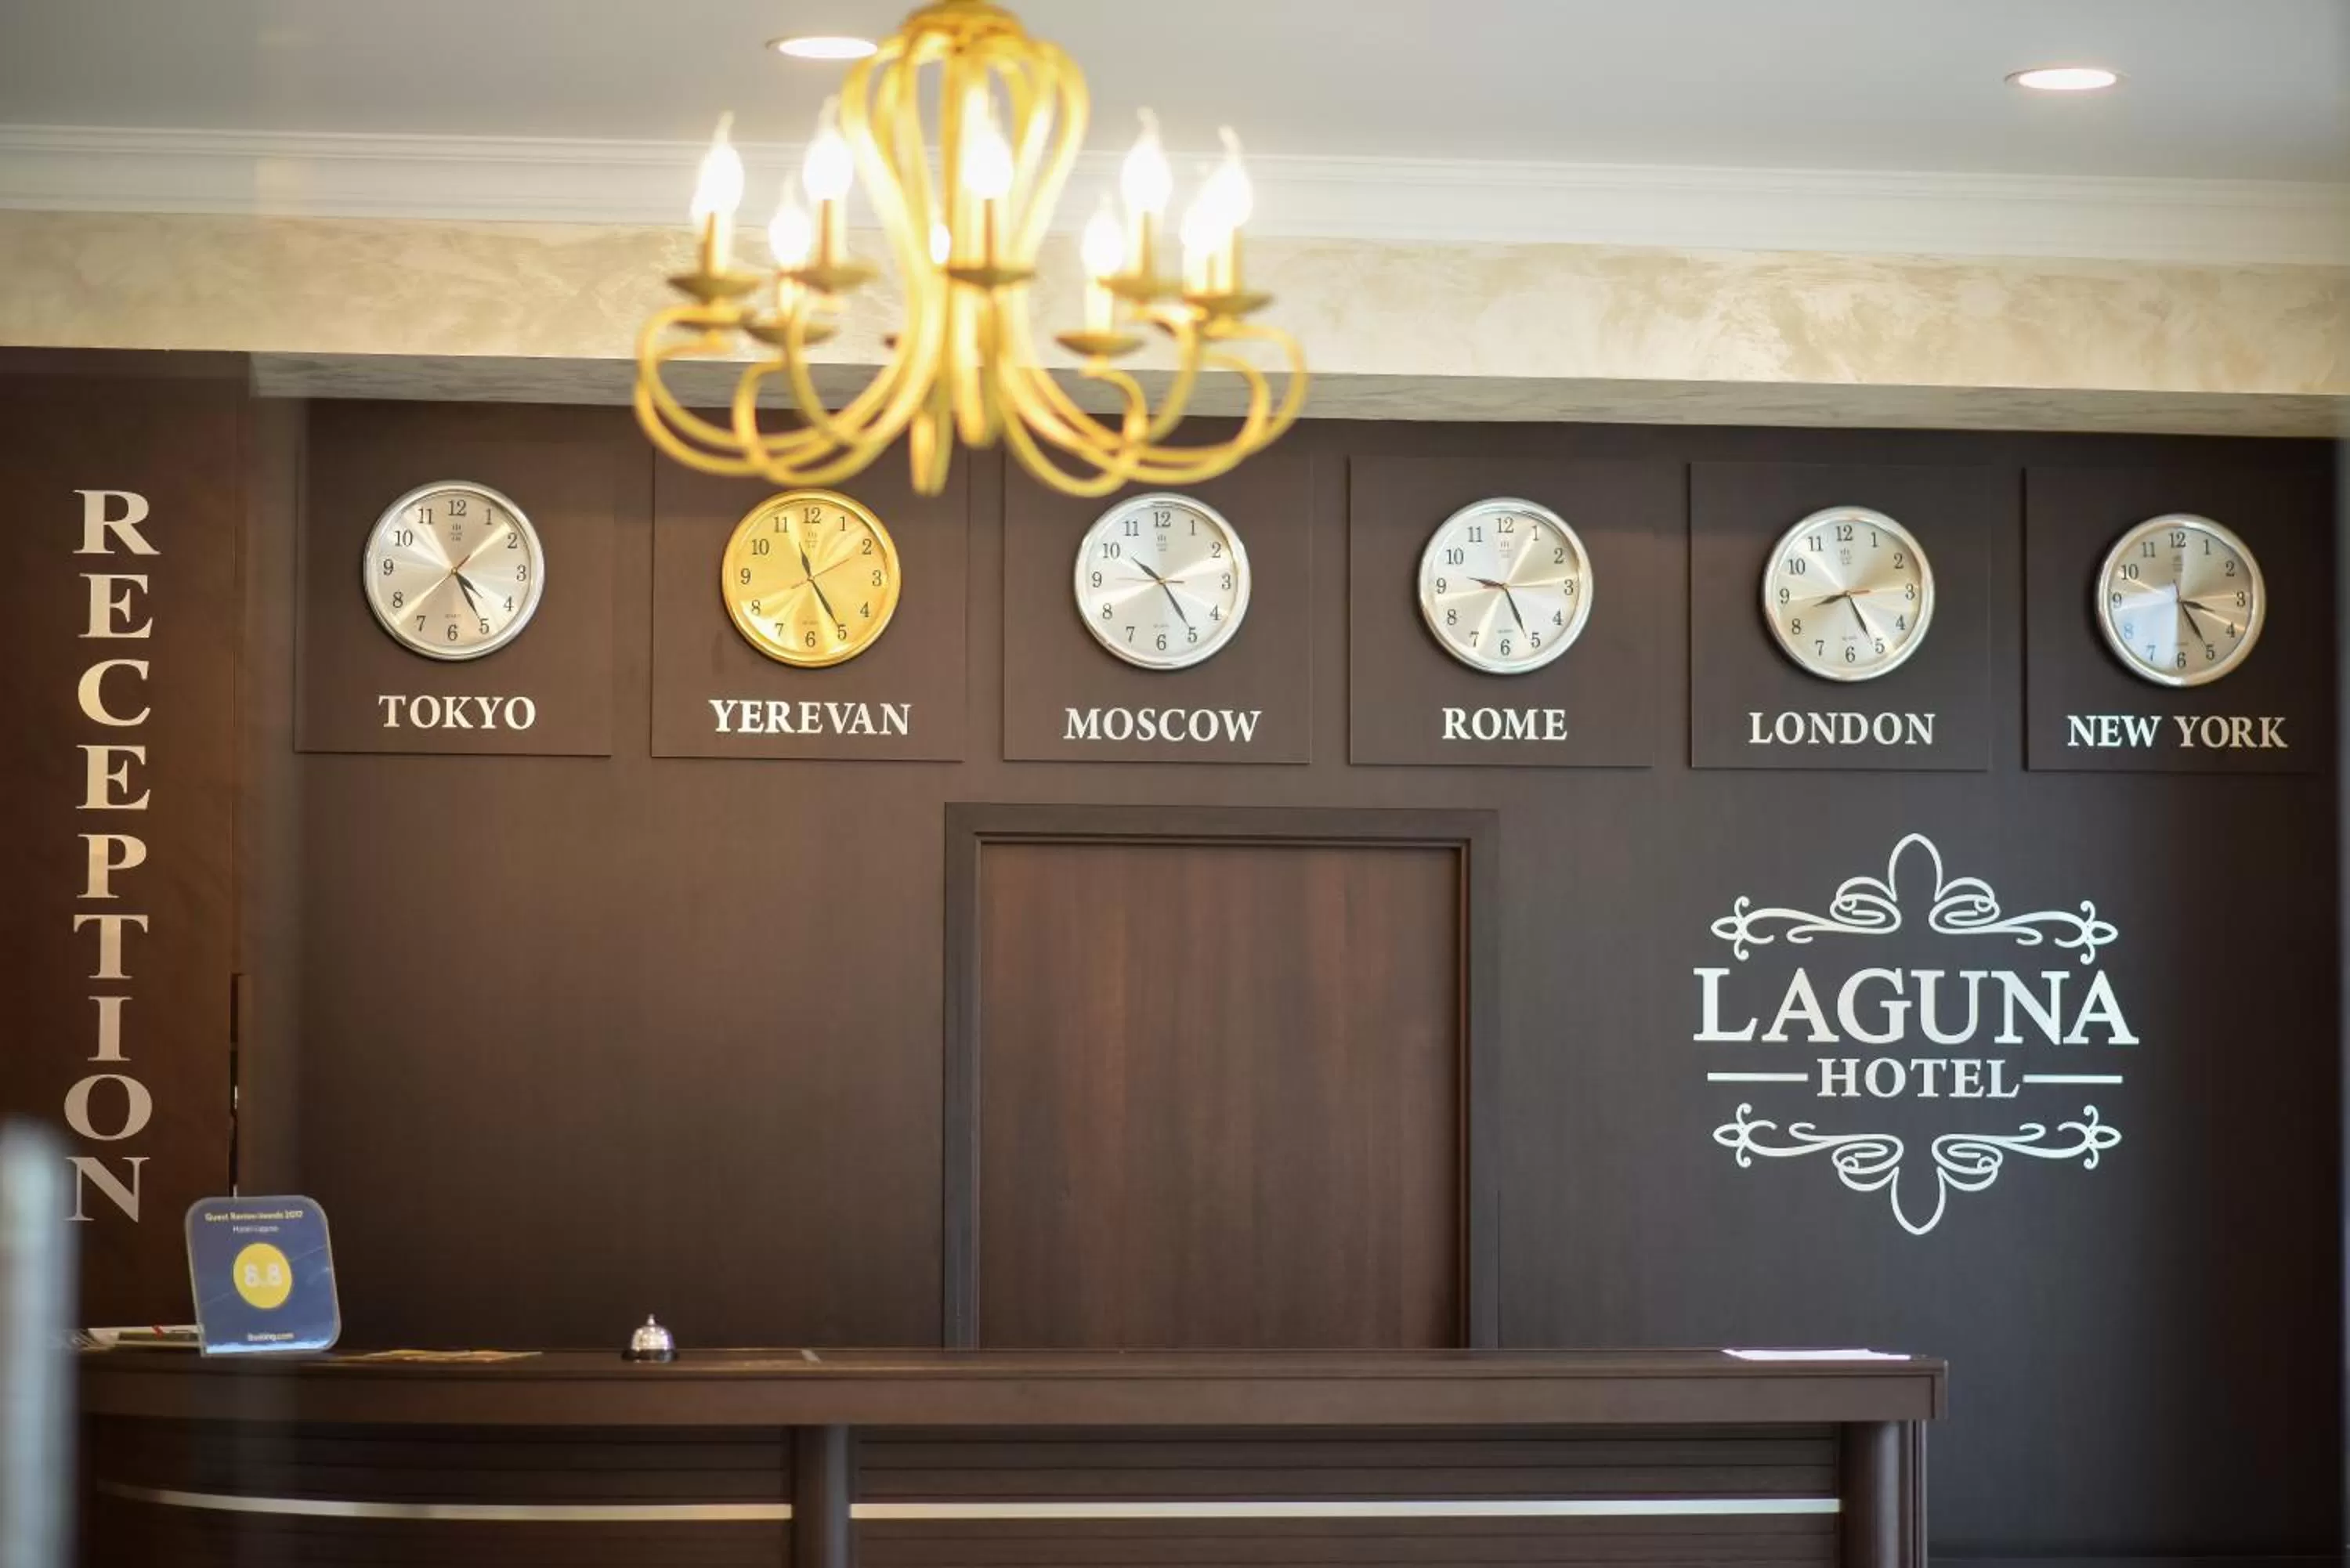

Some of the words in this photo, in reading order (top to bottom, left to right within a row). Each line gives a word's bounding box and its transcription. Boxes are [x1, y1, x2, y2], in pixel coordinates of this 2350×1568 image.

[418, 508, 433, 525] 11
[448, 500, 467, 517] 12
[485, 508, 492, 525] 1
[803, 507, 821, 524] 12
[774, 517, 788, 533] 11
[840, 517, 846, 531] 1
[1153, 511, 1171, 528] 12
[1495, 517, 1513, 533] 12
[1123, 521, 1139, 537] 11
[1189, 520, 1196, 536] 1
[1467, 526, 1483, 543] 11
[1532, 526, 1539, 541] 1
[1835, 525, 1853, 541] 12
[394, 530, 413, 547] 10
[507, 533, 518, 549] 2
[1808, 537, 1824, 552] 11
[1871, 532, 1879, 547] 1
[2169, 532, 2186, 548] 12
[751, 539, 770, 555] 10
[862, 539, 872, 555] 2
[1102, 542, 1120, 558] 10
[1211, 542, 1221, 558] 2
[2142, 542, 2156, 558] 11
[2204, 539, 2211, 555] 1
[1446, 548, 1464, 564] 10
[1553, 548, 1564, 564] 2
[1893, 553, 1904, 569] 2
[383, 558, 394, 576] 9
[516, 565, 526, 581] 3
[1788, 558, 1806, 575] 10
[2121, 564, 2138, 580] 10
[2225, 561, 2235, 576] 2
[740, 568, 751, 584] 9
[872, 570, 882, 587] 3
[1092, 571, 1102, 587] 9
[1222, 573, 1231, 589] 3
[1436, 578, 1447, 594] 9
[1564, 580, 1574, 595] 3
[1905, 583, 1915, 600] 3
[392, 591, 403, 608] 8
[503, 596, 514, 612] 4
[1780, 588, 1790, 604] 9
[2113, 593, 2122, 609] 9
[2236, 591, 2246, 608] 3
[751, 600, 761, 616] 8
[860, 602, 870, 618] 4
[1102, 603, 1112, 620] 8
[1209, 605, 1221, 620] 4
[417, 616, 426, 632] 7
[1447, 609, 1457, 625] 8
[1553, 610, 1562, 625] 4
[1896, 614, 1905, 630] 4
[447, 625, 458, 641] 6
[479, 618, 490, 634] 5
[776, 623, 783, 637] 7
[837, 624, 847, 641] 5
[1791, 618, 1801, 634] 8
[2124, 623, 2134, 639] 8
[2226, 622, 2235, 638] 4
[805, 630, 815, 647] 6
[1126, 626, 1135, 643] 7
[1156, 634, 1166, 650] 6
[1188, 627, 1198, 643] 5
[1470, 631, 1479, 647] 7
[1531, 632, 1541, 648] 5
[1501, 639, 1510, 656] 6
[1815, 640, 1824, 656] 7
[1845, 646, 1856, 663] 6
[1875, 639, 1885, 654] 5
[2147, 645, 2156, 661] 7
[2206, 644, 2214, 659] 5
[2177, 652, 2186, 667] 6
[378, 695, 537, 731] TOKYO
[707, 698, 913, 736] YEREVAN
[1062, 706, 1263, 743] MOSCOW
[1441, 707, 1568, 741] ROME
[1748, 711, 1936, 746] LONDON
[2067, 714, 2162, 748] NEW
[2173, 715, 2287, 748] YORK
[64, 490, 160, 1223] RECEPTION
[1693, 966, 2140, 1046] LAGUNA
[1817, 1057, 2020, 1098] HOTEL
